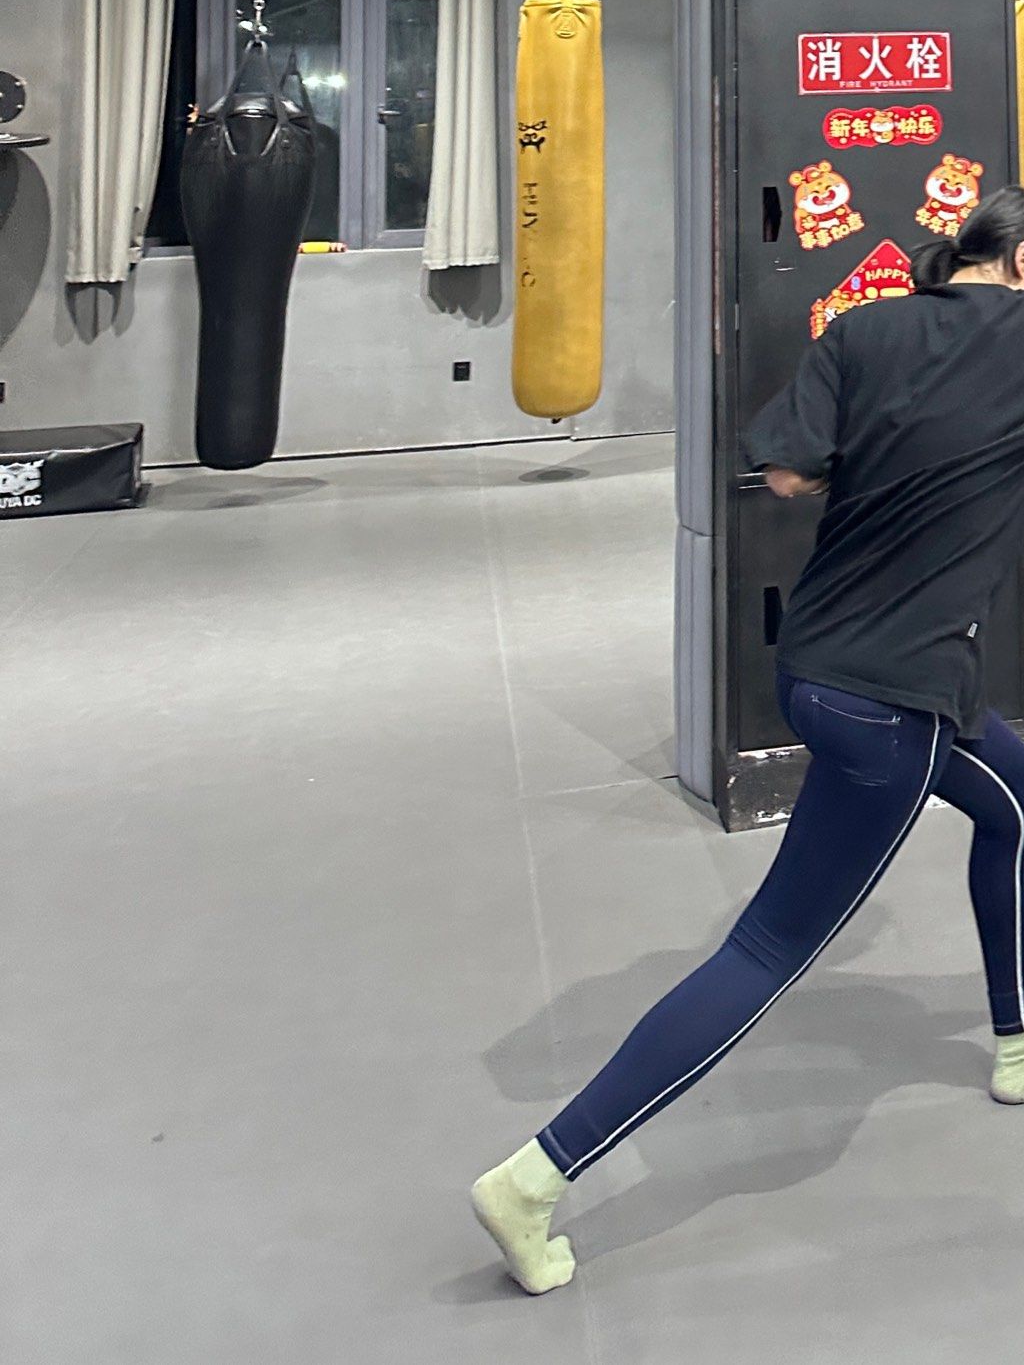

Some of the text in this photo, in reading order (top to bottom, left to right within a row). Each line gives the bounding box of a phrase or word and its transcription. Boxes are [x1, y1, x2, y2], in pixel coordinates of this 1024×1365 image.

[807, 37, 943, 81] 消火栓
[870, 80, 914, 88] HYDRANT
[829, 116, 936, 138] 新年 快乐
[865, 267, 911, 283] HAPPY
[0, 495, 42, 508] UYA DC
